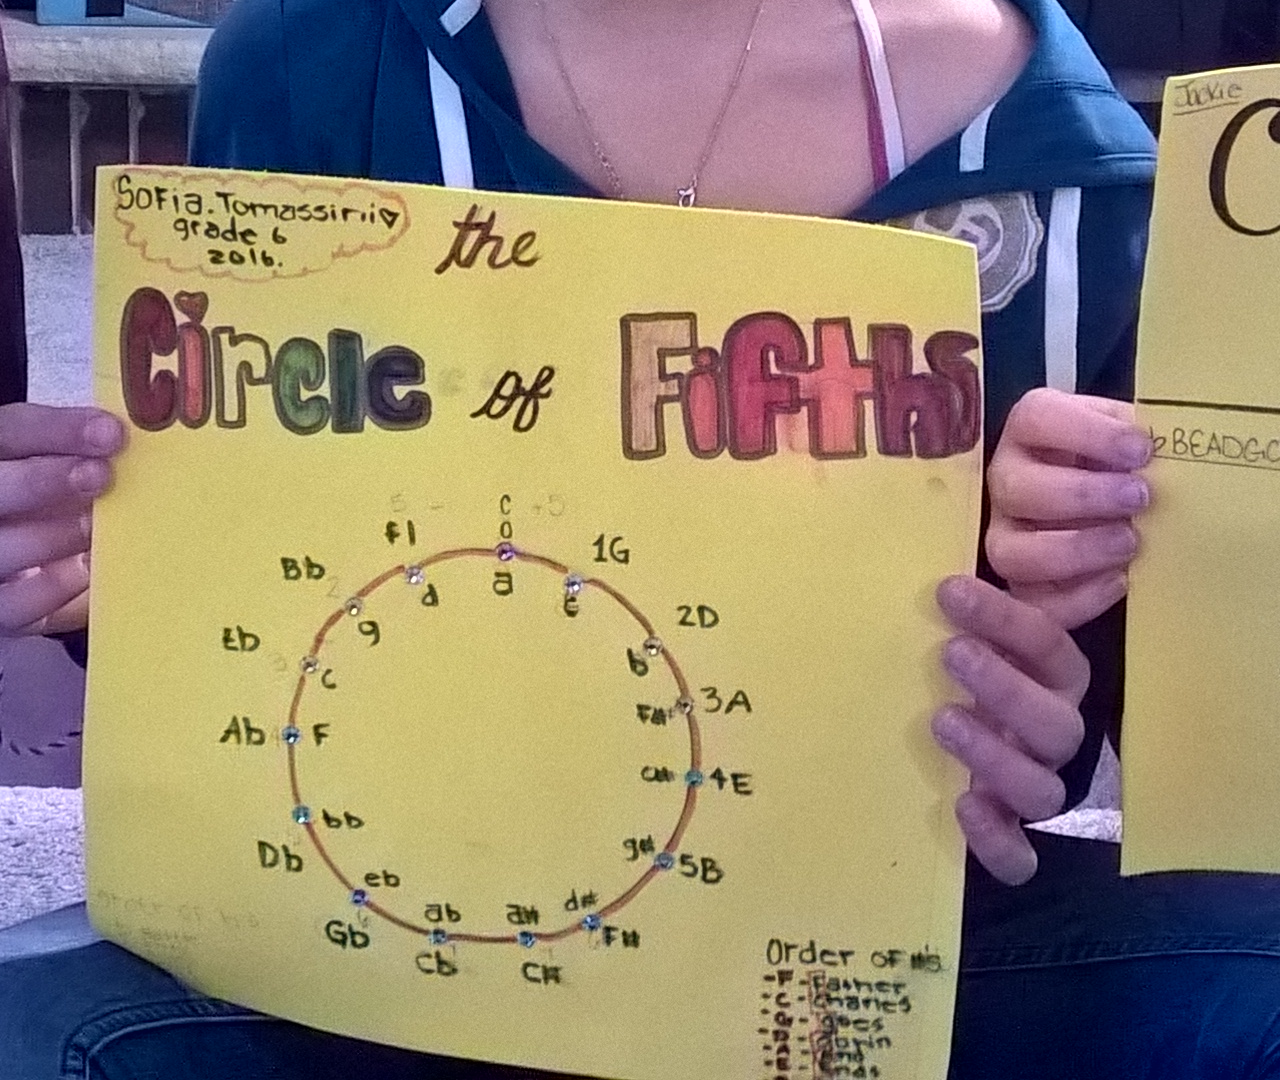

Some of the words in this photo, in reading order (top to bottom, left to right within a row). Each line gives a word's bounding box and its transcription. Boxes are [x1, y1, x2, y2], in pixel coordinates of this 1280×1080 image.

[1174, 80, 1243, 110] Jackie
[174, 218, 258, 246] grade
[272, 227, 288, 245] 6
[434, 203, 542, 274] the
[121, 286, 432, 435] Circle
[471, 365, 556, 432] of
[619, 311, 982, 461] Fifths
[280, 556, 326, 581] Bb
[421, 583, 439, 607] d
[493, 572, 514, 597] a
[627, 648, 649, 677] b
[220, 715, 266, 746] Ab
[322, 808, 365, 830] bb
[258, 840, 304, 873] Db
[364, 870, 401, 888] eb
[424, 903, 462, 924] ab
[325, 919, 370, 950] Gb
[415, 951, 459, 977] Cb
[766, 938, 855, 966] Order
